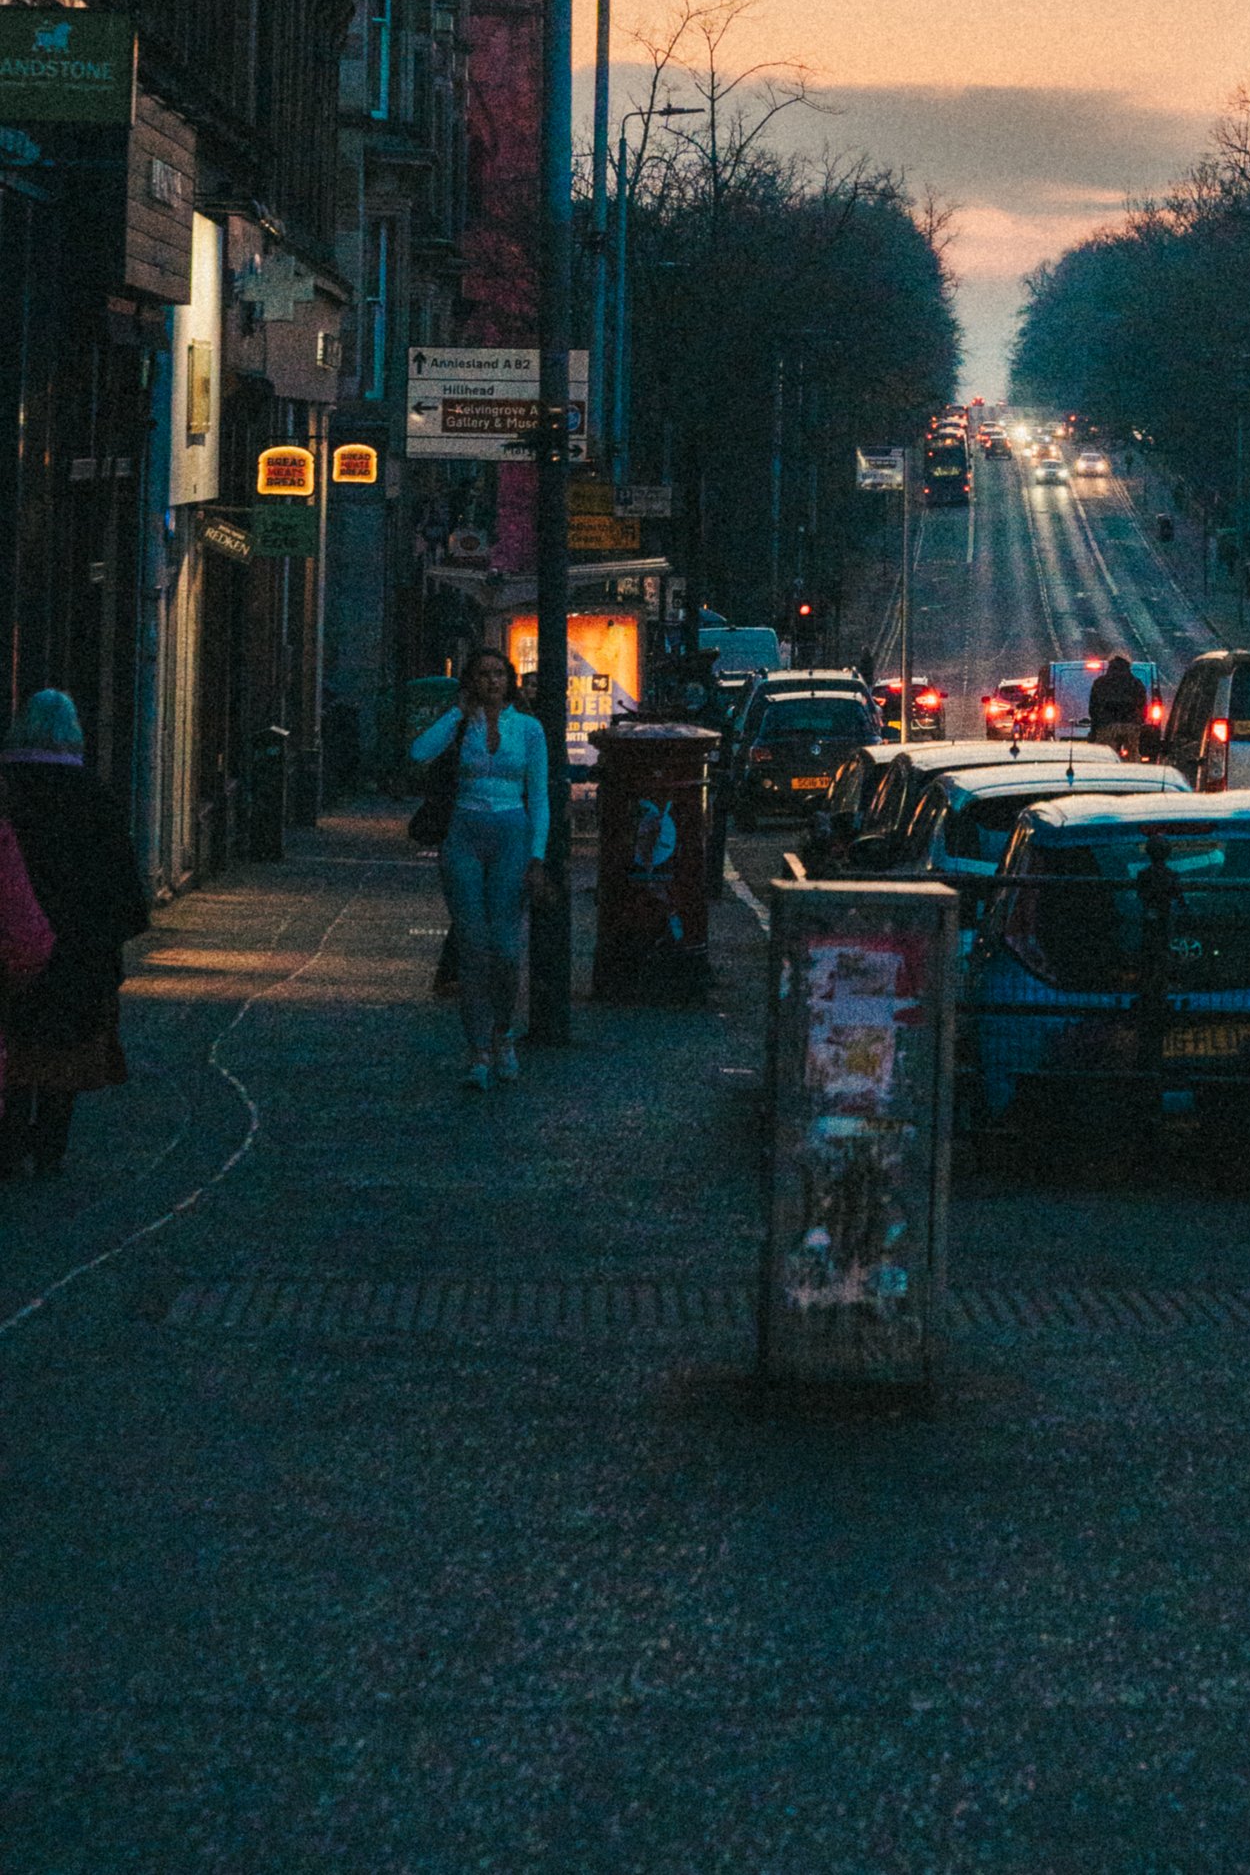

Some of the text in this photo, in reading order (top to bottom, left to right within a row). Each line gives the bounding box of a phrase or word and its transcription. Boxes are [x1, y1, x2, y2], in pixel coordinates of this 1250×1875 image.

[0, 57, 113, 81] ANDSTONE
[430, 358, 499, 370] Anniesland
[443, 385, 494, 396] Hillhead
[455, 404, 526, 417] Kelvingrove
[446, 416, 490, 429] Gallery
[494, 418, 502, 427] &
[267, 457, 305, 467] BREAD
[267, 467, 305, 477] MEATS
[267, 477, 305, 487] BREAD
[205, 526, 250, 557] REDKEN
